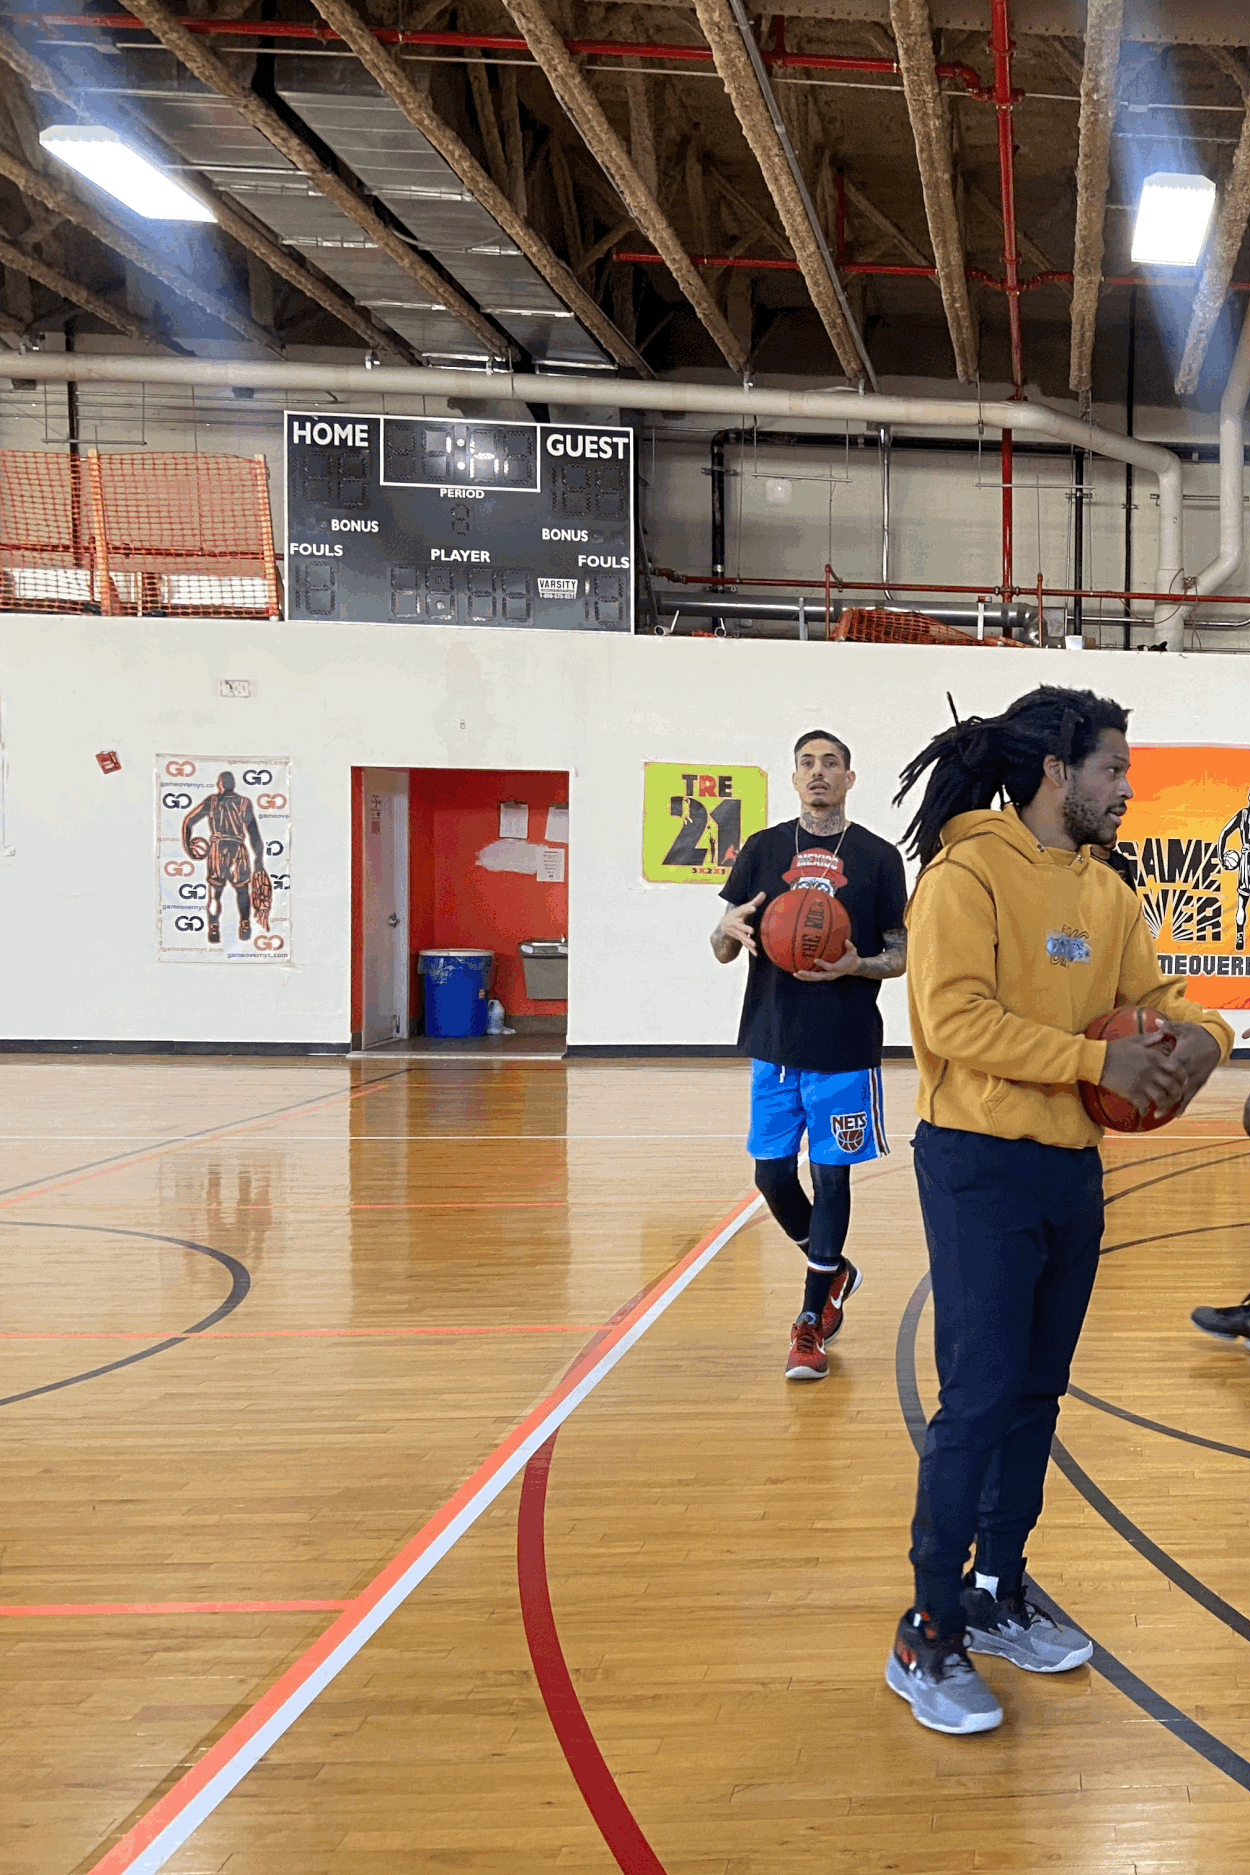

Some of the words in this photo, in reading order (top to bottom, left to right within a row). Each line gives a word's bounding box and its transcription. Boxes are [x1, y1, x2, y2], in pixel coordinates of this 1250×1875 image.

[293, 421, 369, 447] HOME
[546, 434, 629, 460] GUEST
[440, 488, 485, 499] PERIOD
[331, 519, 379, 533] BONUS
[542, 528, 589, 543] BONUS
[290, 543, 344, 557] FOULS
[430, 548, 491, 563] PLAYER
[578, 554, 630, 569] FOULS
[539, 579, 577, 589] VARSITY
[681, 773, 733, 798] TRE
[661, 796, 742, 867] 21
[796, 852, 839, 870] MEXICO
[1116, 837, 1222, 893] GAME
[1142, 888, 1222, 942] VER
[832, 1113, 867, 1136] NETS
